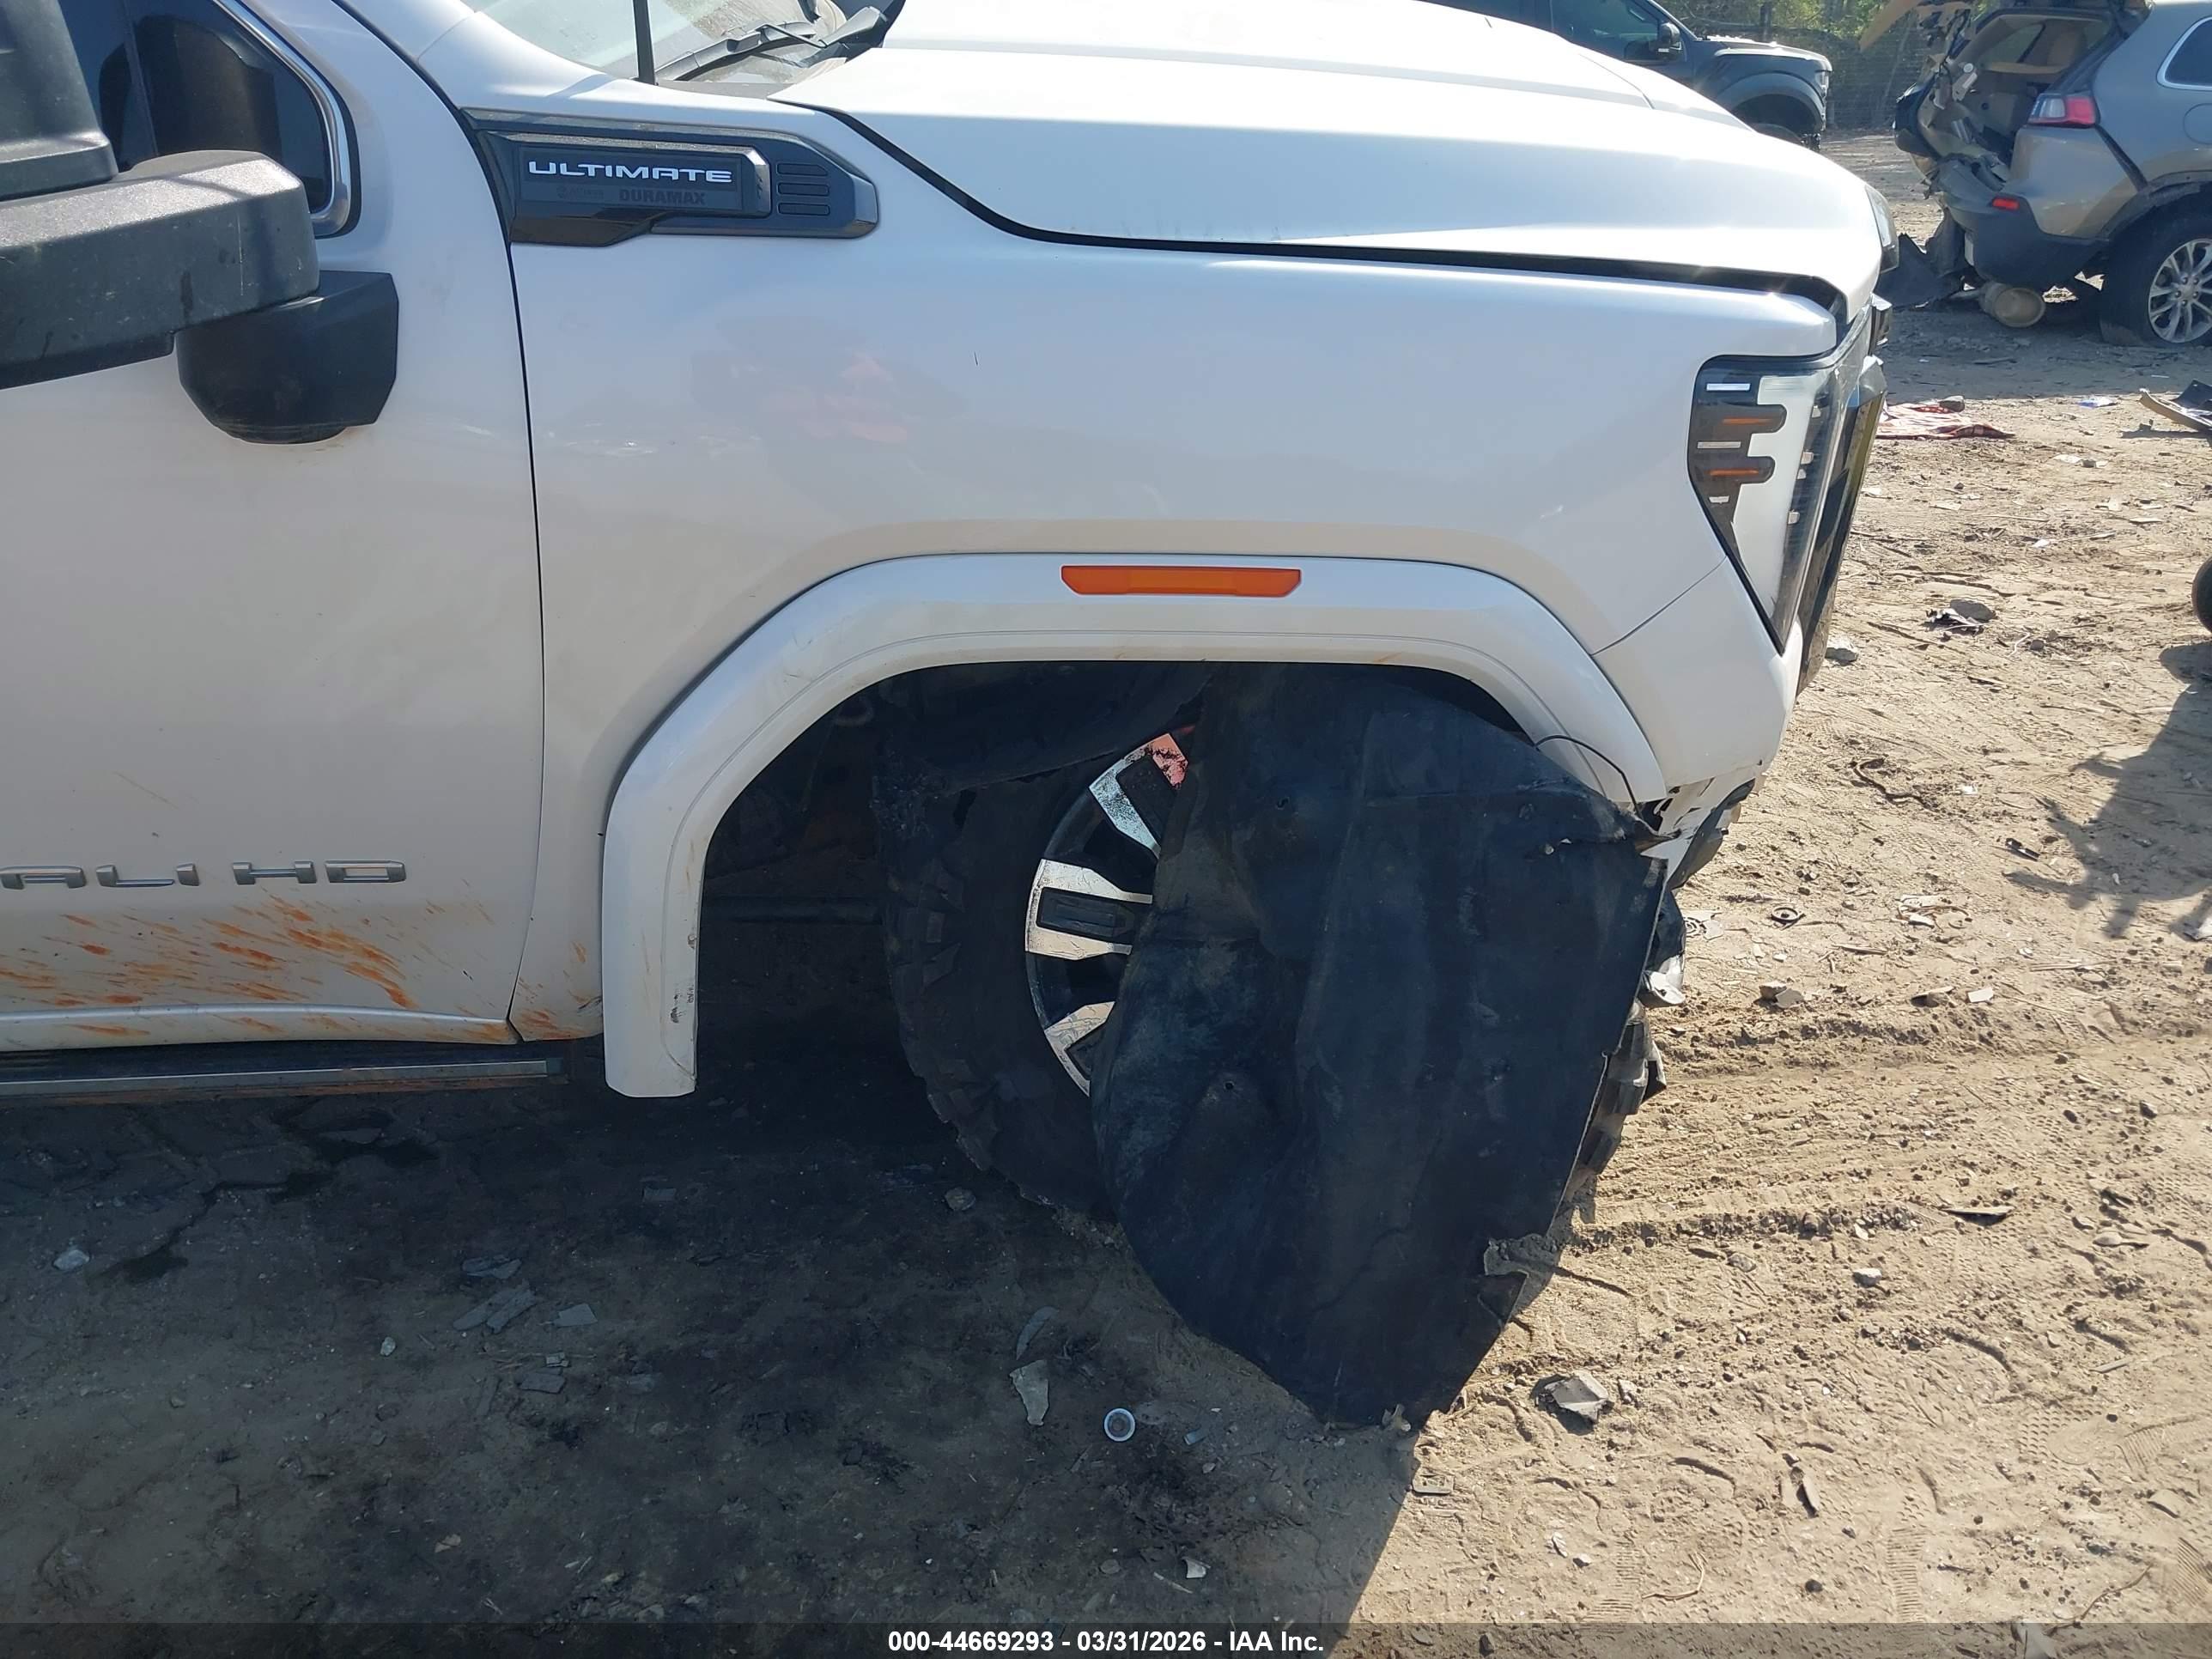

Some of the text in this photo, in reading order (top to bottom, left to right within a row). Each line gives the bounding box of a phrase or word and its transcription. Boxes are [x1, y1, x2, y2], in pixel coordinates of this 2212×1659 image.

[529, 161, 732, 183] ULTIMATE
[619, 188, 705, 206] DURAMAX
[232, 860, 407, 885] HD
